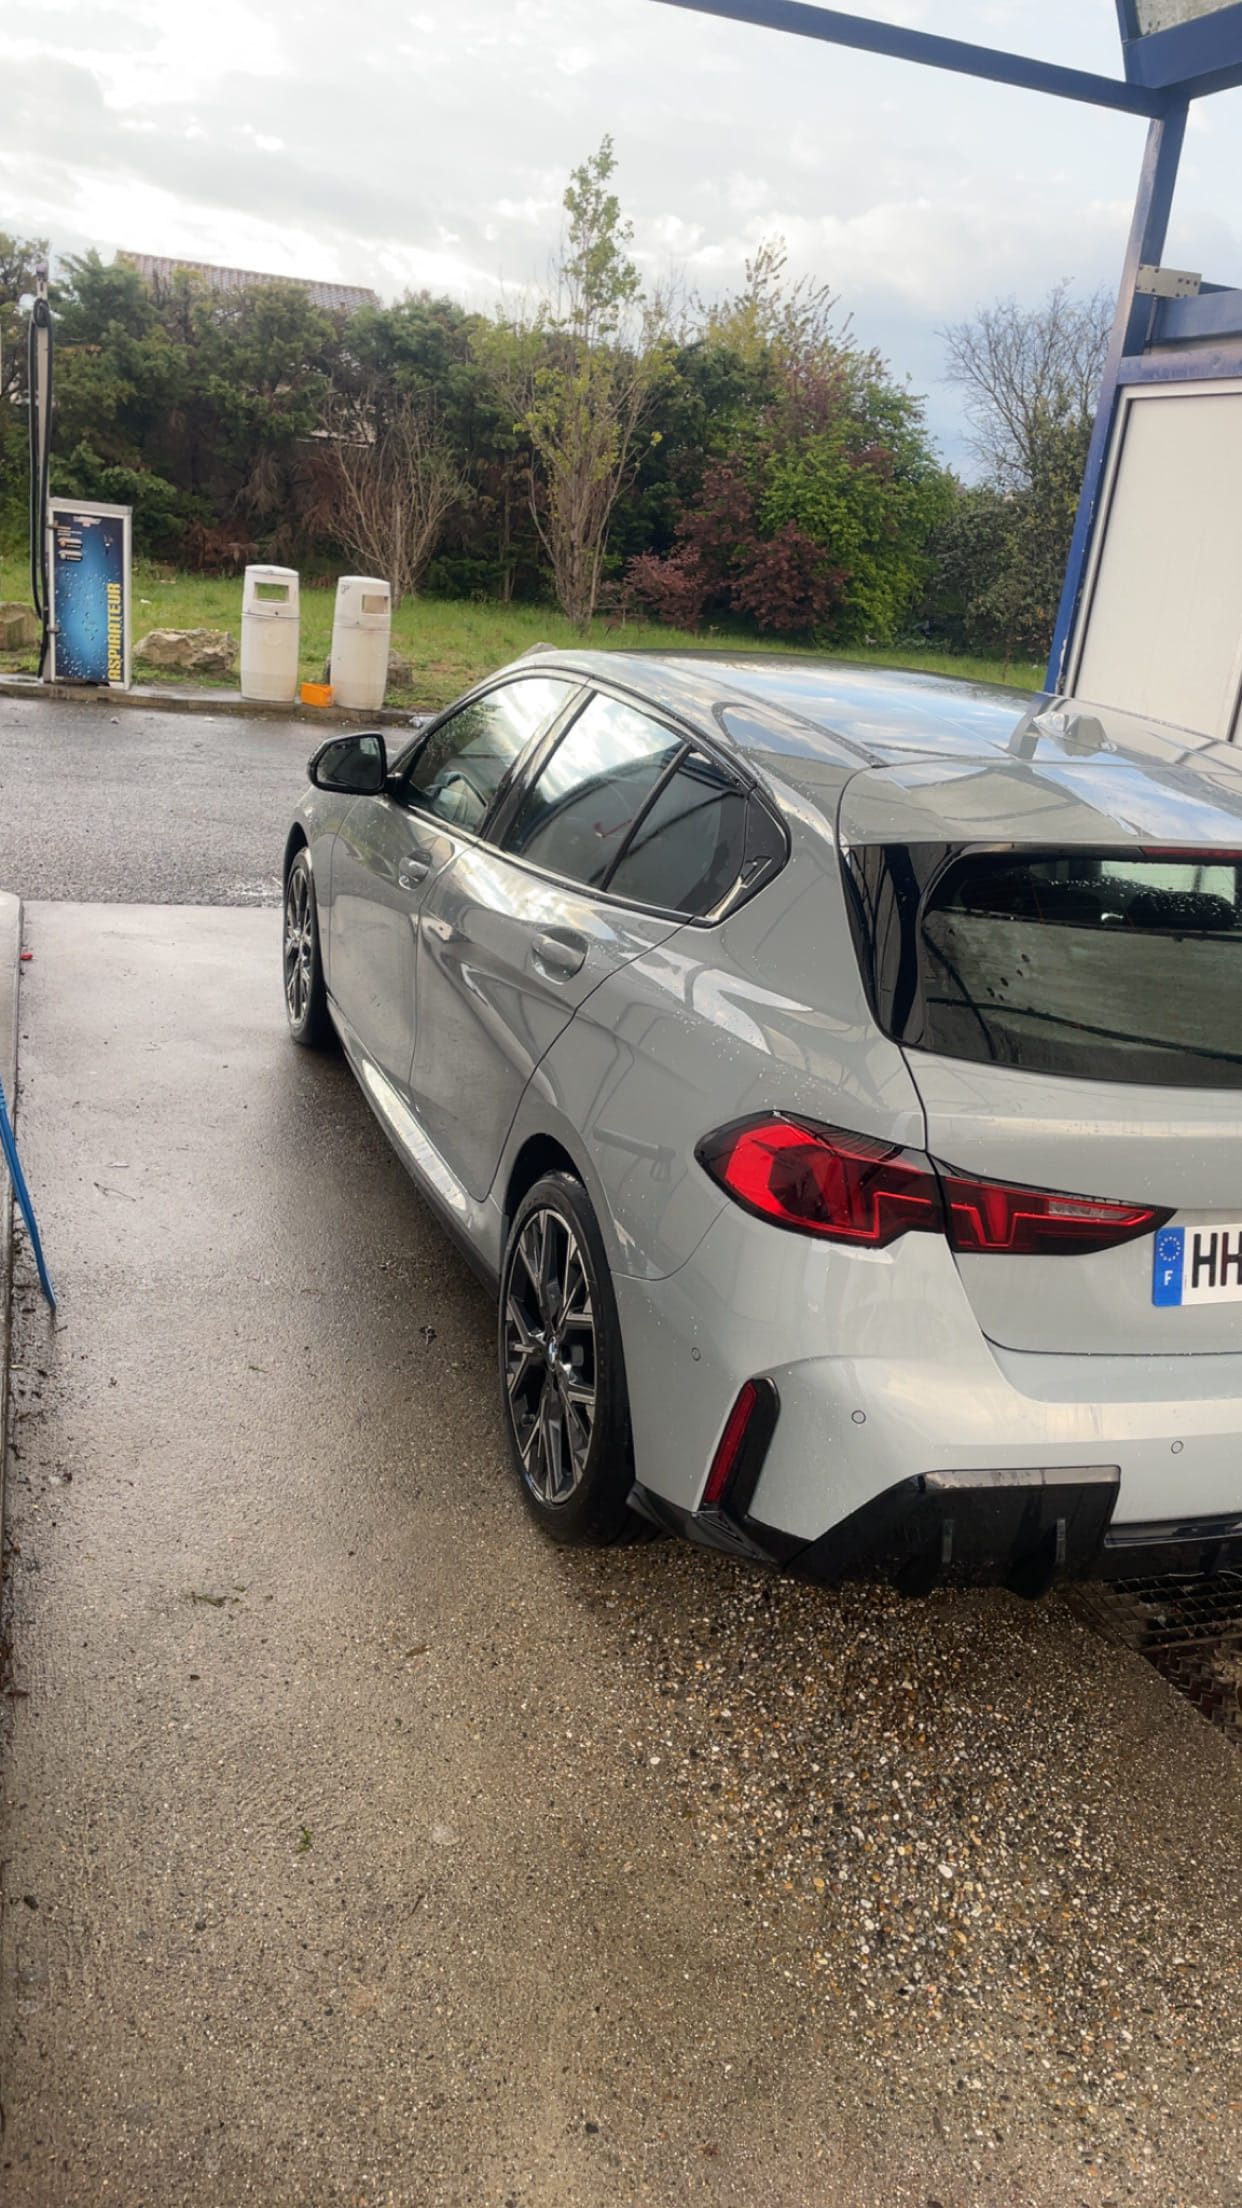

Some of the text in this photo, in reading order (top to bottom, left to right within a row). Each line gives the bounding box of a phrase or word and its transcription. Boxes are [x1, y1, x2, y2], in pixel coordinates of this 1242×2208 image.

[107, 583, 121, 681] ASPIRATEUR
[1164, 1270, 1173, 1286] F
[1192, 1231, 1242, 1288] HH
